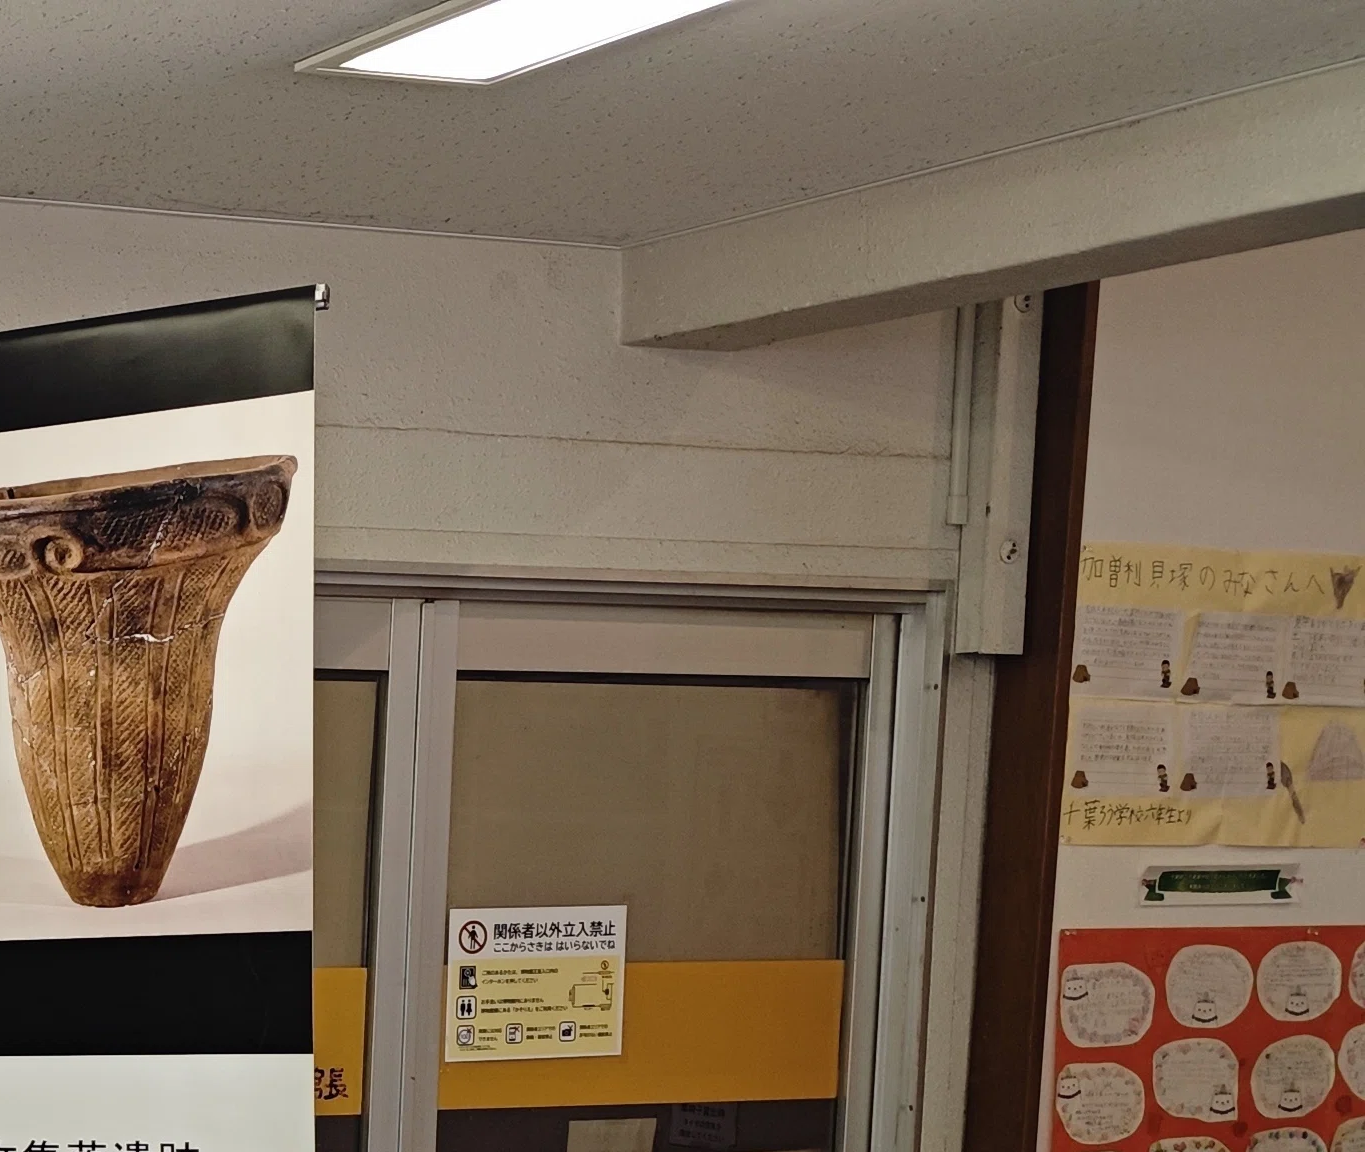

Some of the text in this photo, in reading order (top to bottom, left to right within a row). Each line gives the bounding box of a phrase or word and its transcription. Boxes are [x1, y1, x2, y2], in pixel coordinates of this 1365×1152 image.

[1080, 556, 1325, 598] 加曽利貝塚のみなさんへ
[493, 919, 616, 939] 関係者以外立入禁止
[493, 939, 615, 953] ここからさきは はいらないでね
